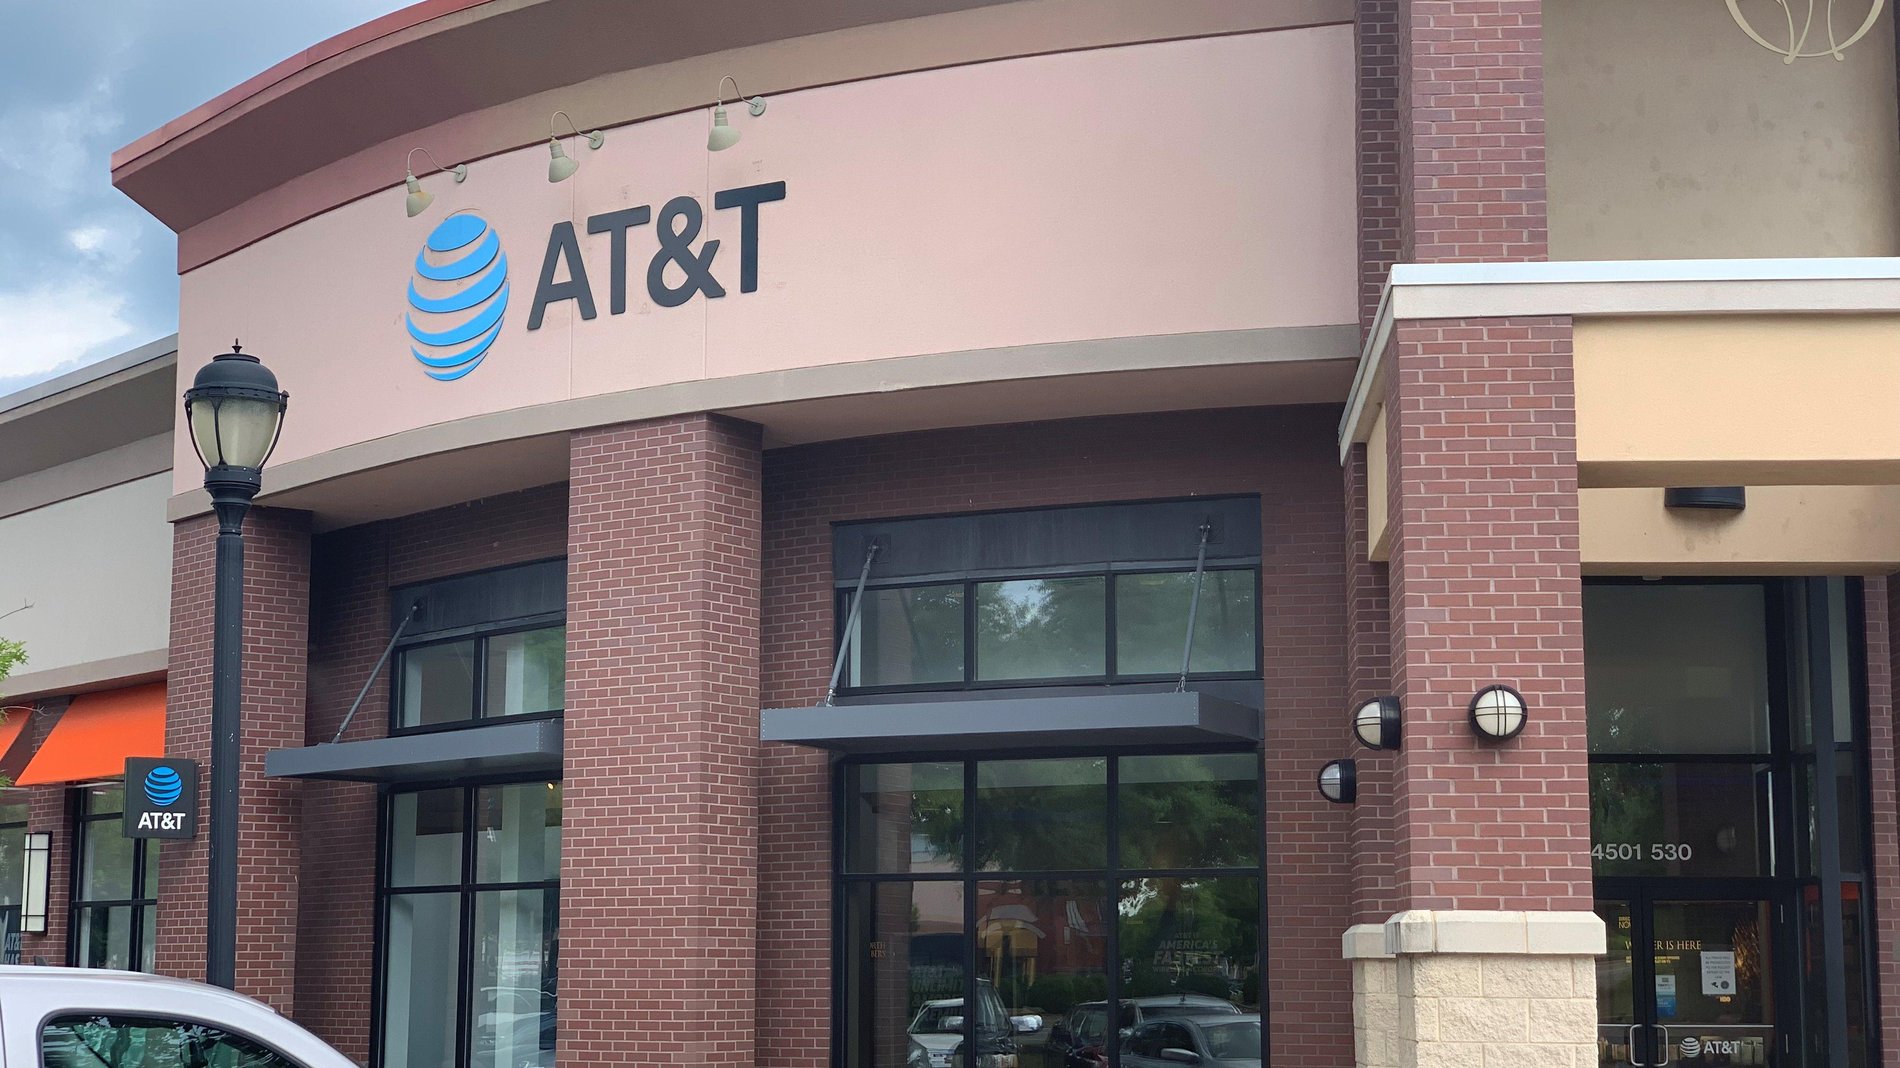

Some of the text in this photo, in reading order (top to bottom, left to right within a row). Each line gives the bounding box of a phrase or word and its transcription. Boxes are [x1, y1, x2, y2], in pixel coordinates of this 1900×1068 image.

[527, 180, 786, 330] AT&T
[138, 812, 186, 830] AT&T
[1591, 843, 1692, 861] 4501 530
[4, 932, 21, 950] AT&
[1666, 940, 1674, 950] IS
[1677, 940, 1702, 950] HERE
[1704, 1041, 1740, 1054] AT&T
